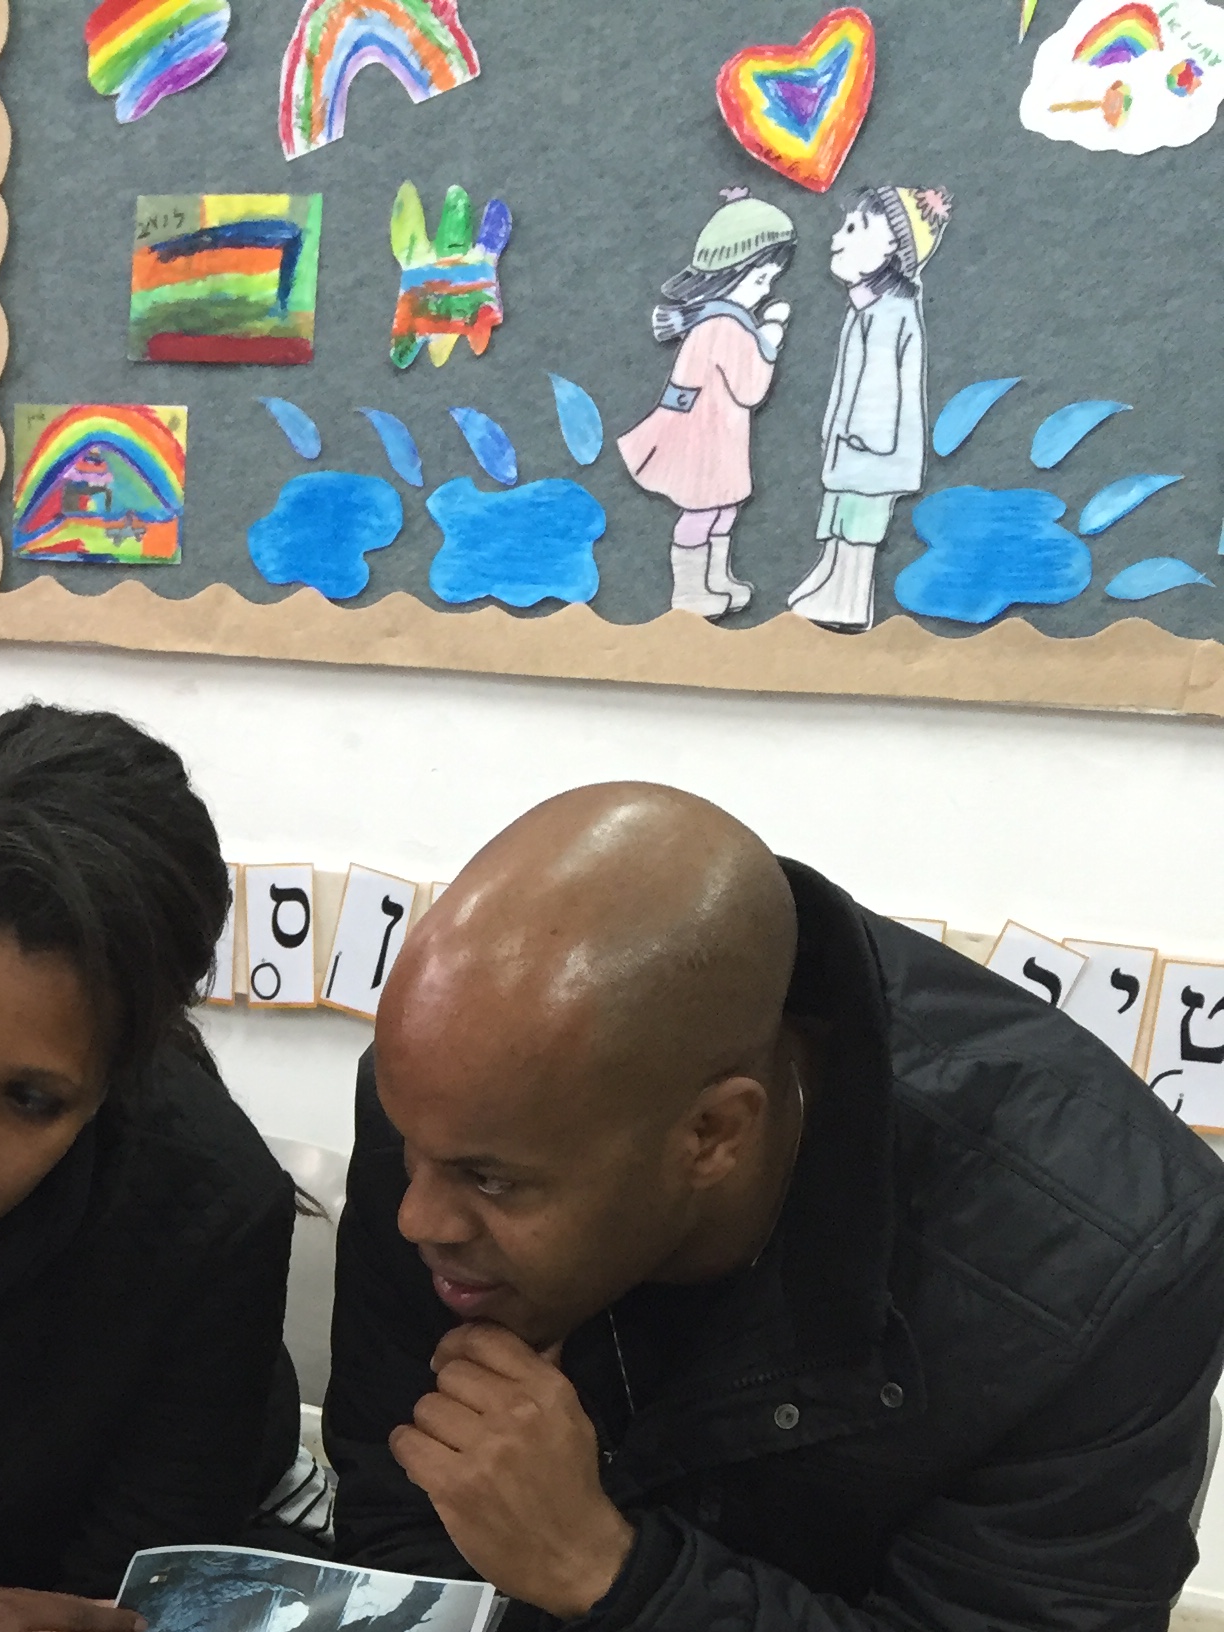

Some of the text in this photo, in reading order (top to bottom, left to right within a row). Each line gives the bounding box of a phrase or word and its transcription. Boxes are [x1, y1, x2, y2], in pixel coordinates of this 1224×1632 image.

[269, 882, 311, 949] ס
[370, 894, 405, 990] ן
[1110, 967, 1141, 1015] י
[1180, 985, 1224, 1065] ט
